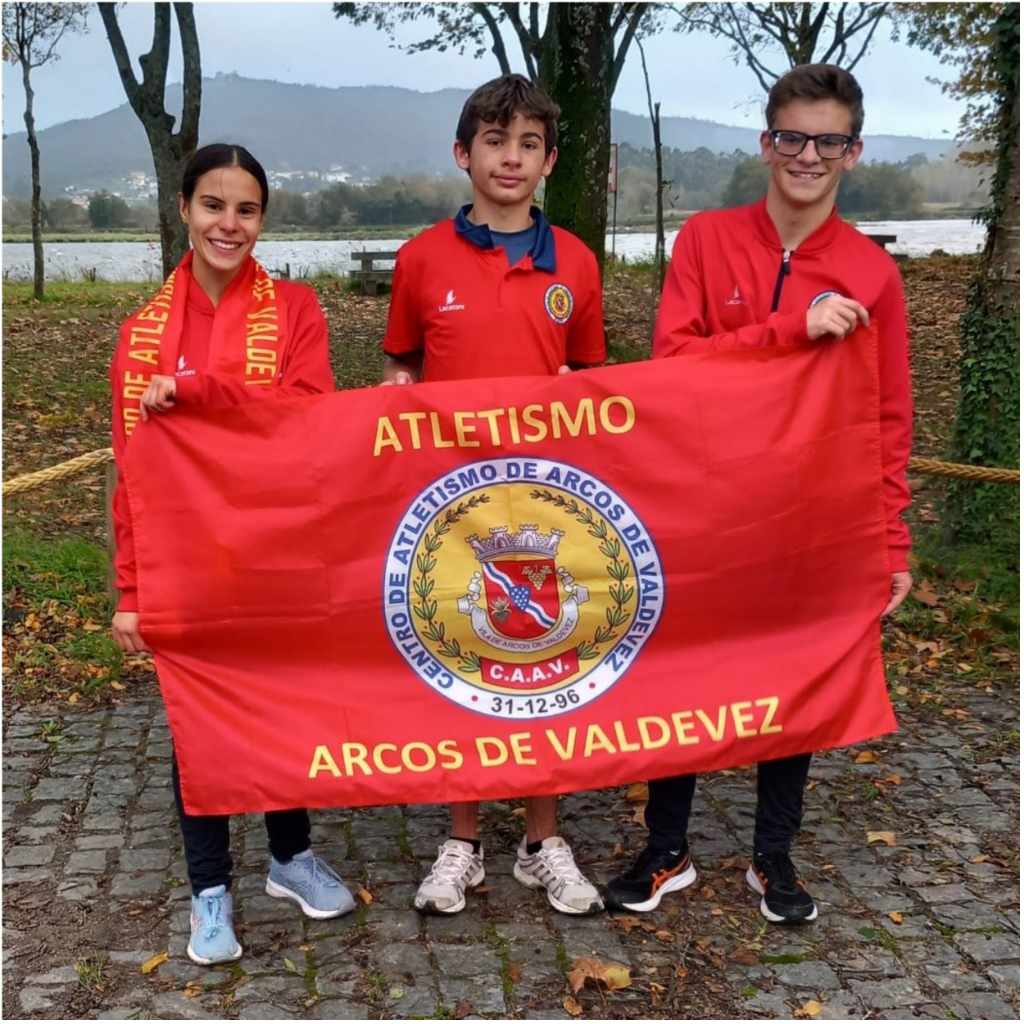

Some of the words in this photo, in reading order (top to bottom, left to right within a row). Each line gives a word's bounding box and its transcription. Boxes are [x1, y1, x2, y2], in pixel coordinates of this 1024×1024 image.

[244, 307, 278, 386] VALDE
[373, 395, 636, 456] ATLETISMO
[506, 461, 538, 479] DE
[545, 465, 626, 522] ARCOS
[393, 464, 497, 566] ATLETISMO
[621, 522, 651, 557] DE
[388, 572, 406, 604] DE
[604, 562, 659, 673] VALDEVEZ
[391, 612, 454, 689] CENTRO
[489, 658, 571, 683] C.A.A.V.
[491, 689, 580, 715] 31-12-96
[307, 739, 464, 779] ARCOS
[475, 731, 537, 768] DE
[545, 695, 783, 761] VALDEVEZ
